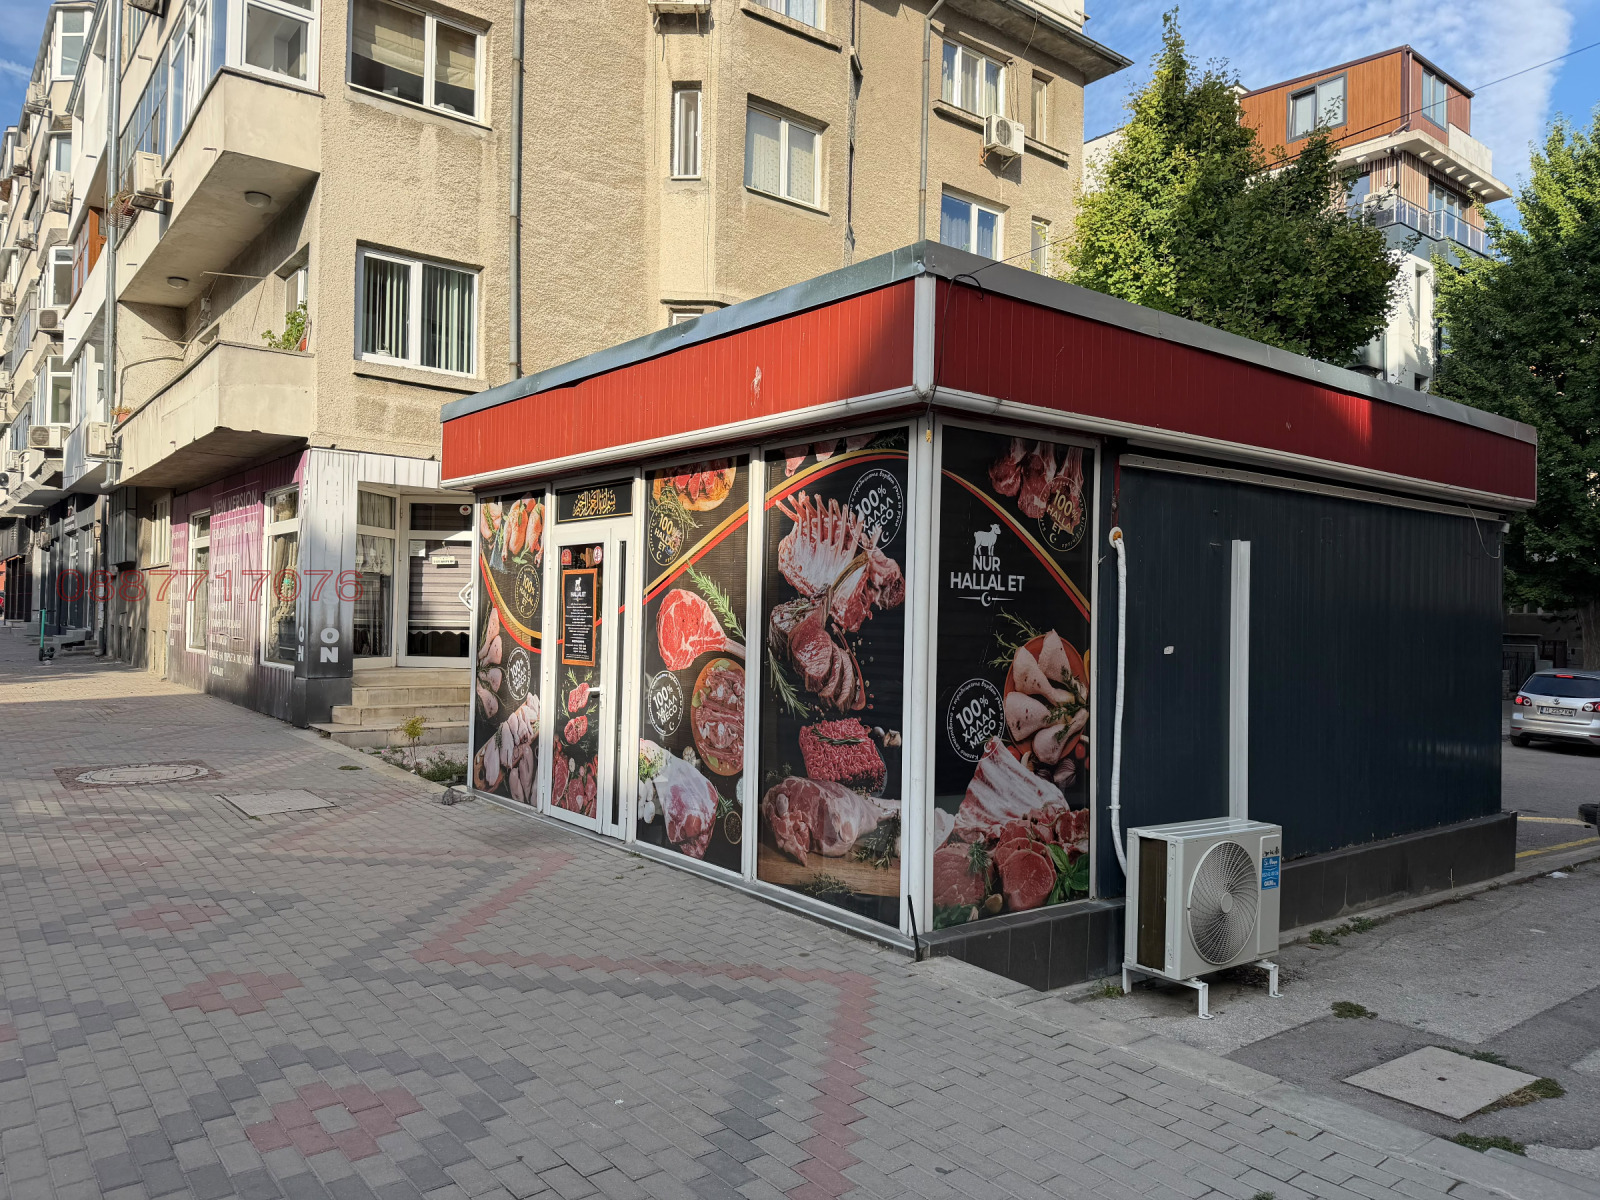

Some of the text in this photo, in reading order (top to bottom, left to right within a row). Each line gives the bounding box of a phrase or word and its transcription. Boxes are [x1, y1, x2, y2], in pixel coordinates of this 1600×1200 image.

[227, 488, 258, 513] VERSION
[855, 484, 887, 520] 100%
[861, 497, 894, 532] ХАЛАЛ
[1054, 489, 1078, 521] 100%
[1046, 505, 1075, 536] HALLAL
[1051, 521, 1062, 535] ET
[972, 555, 1001, 571] NUR
[950, 571, 1025, 592] HALLAL ET
[653, 684, 674, 709] 100%
[656, 695, 678, 720] ХАЛАЛ
[955, 694, 989, 730] 100%
[962, 707, 996, 742] ХАЛАЛ
[969, 720, 996, 749] МЕСО
